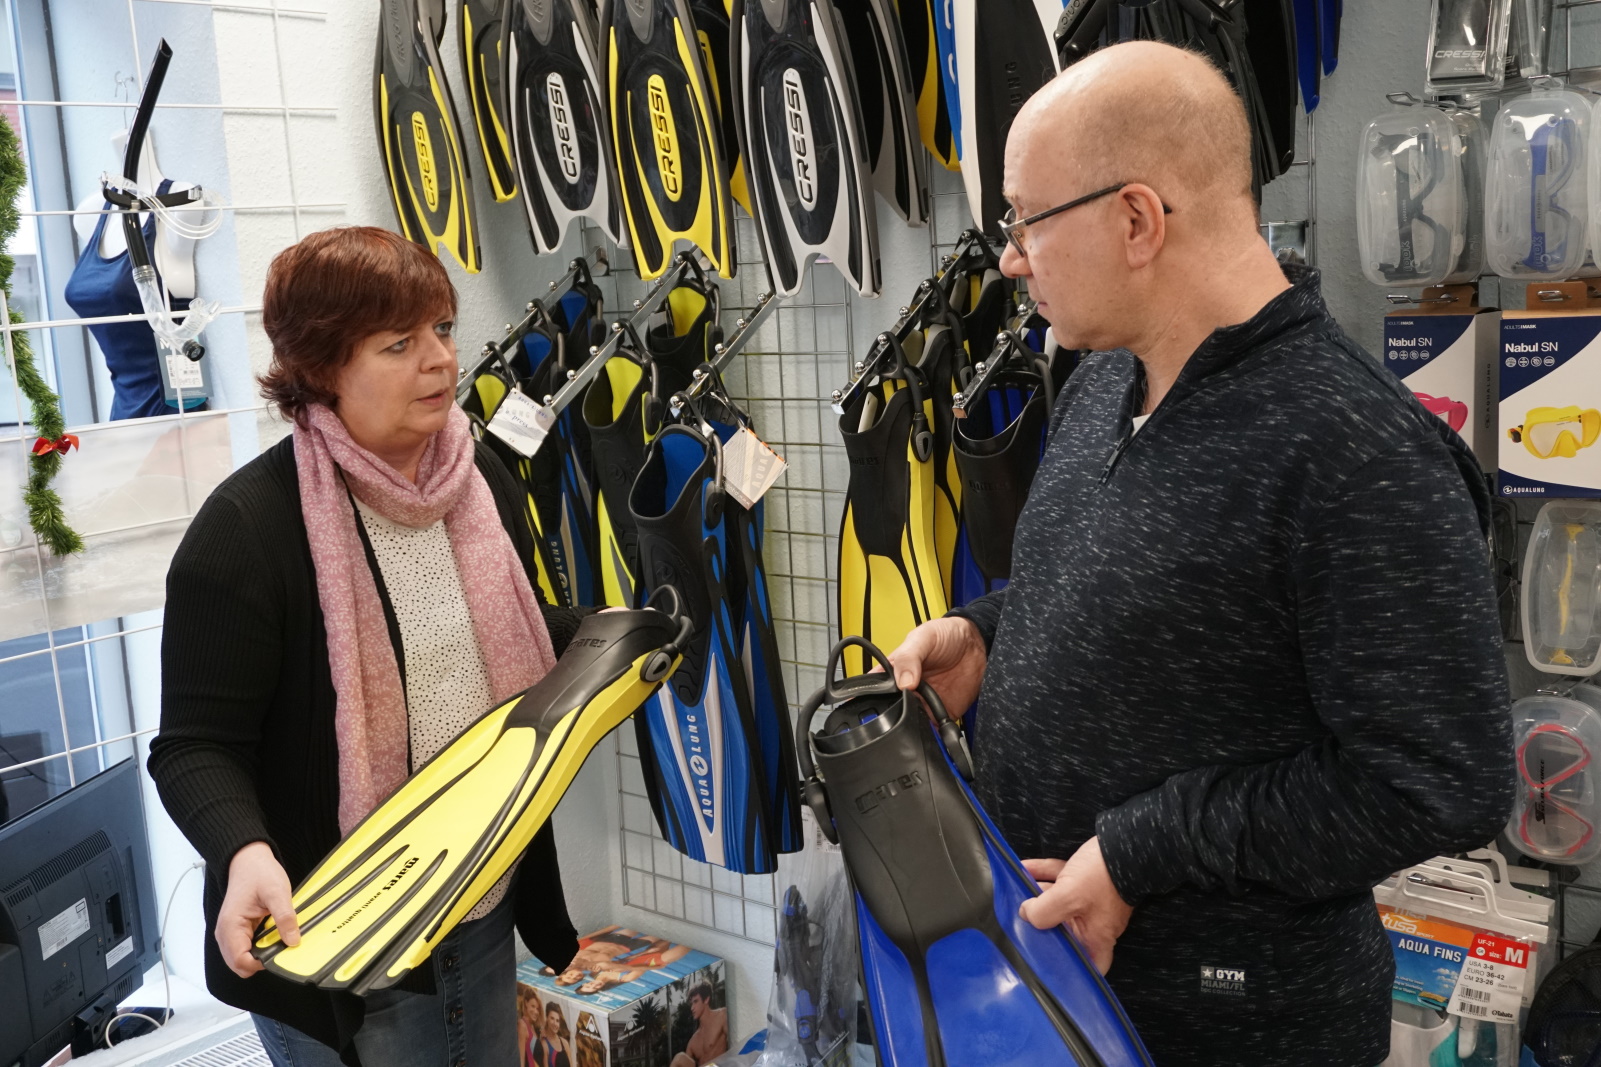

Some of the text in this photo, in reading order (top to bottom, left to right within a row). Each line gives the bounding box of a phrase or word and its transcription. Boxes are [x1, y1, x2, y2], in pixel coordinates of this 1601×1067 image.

[1434, 50, 1487, 59] CRESSI
[549, 81, 578, 179] CRESSI
[649, 84, 679, 195] CRESSI
[785, 78, 814, 204] CRESSI
[412, 118, 436, 207] CRESSI
[1388, 337, 1433, 347] Nabul SN
[1505, 341, 1559, 353] Nabul SN
[686, 714, 714, 818] AQUA LUNG
[854, 770, 923, 815] mares
[382, 857, 420, 891] mares
[1381, 913, 1417, 935] tusa
[1397, 938, 1463, 963] AQUA FINS
[1477, 938, 1495, 947] UF-21
[1489, 951, 1502, 959] size:
[1504, 947, 1525, 965] M
[1468, 960, 1495, 971] USA 3-8
[1216, 969, 1245, 981] GYM
[1463, 974, 1474, 982] CM
[1475, 976, 1494, 986] 23-26
[1466, 967, 1506, 981] EURO 36-42
[1201, 980, 1246, 991] MIAMI/FL
